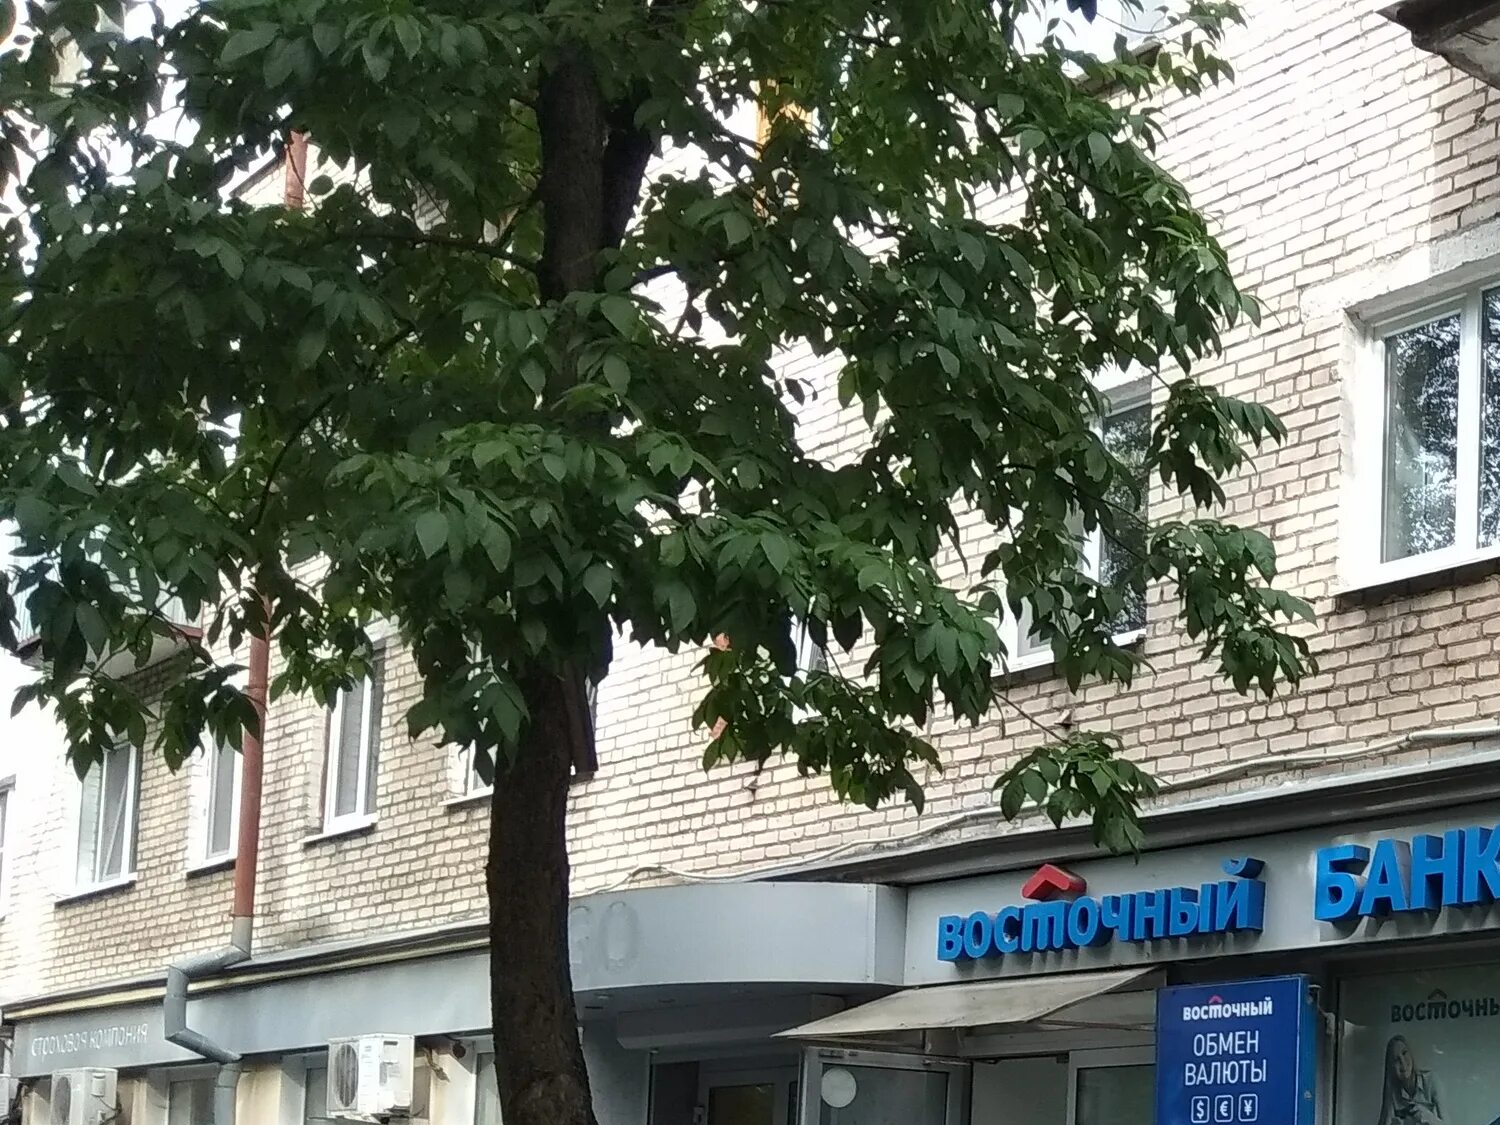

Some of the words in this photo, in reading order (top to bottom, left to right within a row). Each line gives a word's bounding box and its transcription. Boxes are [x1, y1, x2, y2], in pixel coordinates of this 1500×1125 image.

[937, 858, 1265, 962] ВОСТОЧНЫЙ
[1193, 1031, 1260, 1056] ОБМЕН
[1185, 1059, 1267, 1086] ВАЛЮТЫ
